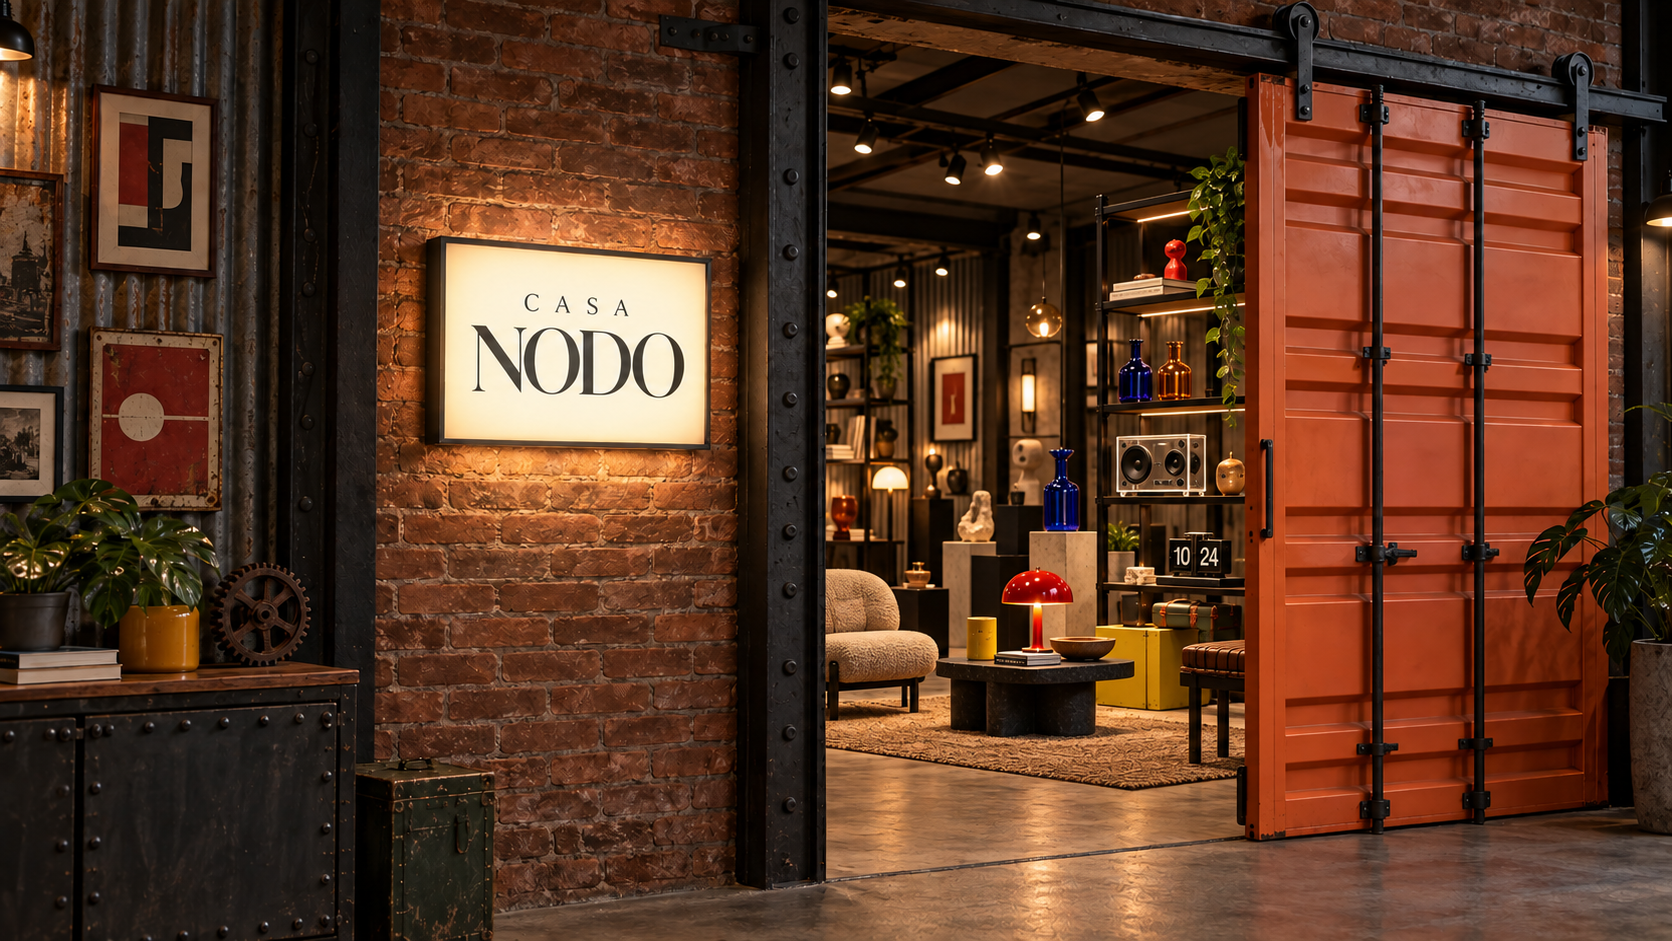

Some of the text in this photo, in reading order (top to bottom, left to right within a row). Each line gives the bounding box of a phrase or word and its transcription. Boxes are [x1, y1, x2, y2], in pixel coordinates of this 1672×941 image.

[524, 293, 629, 317] CASA
[471, 325, 685, 398] NODO
[1173, 546, 1219, 567] 10 24
